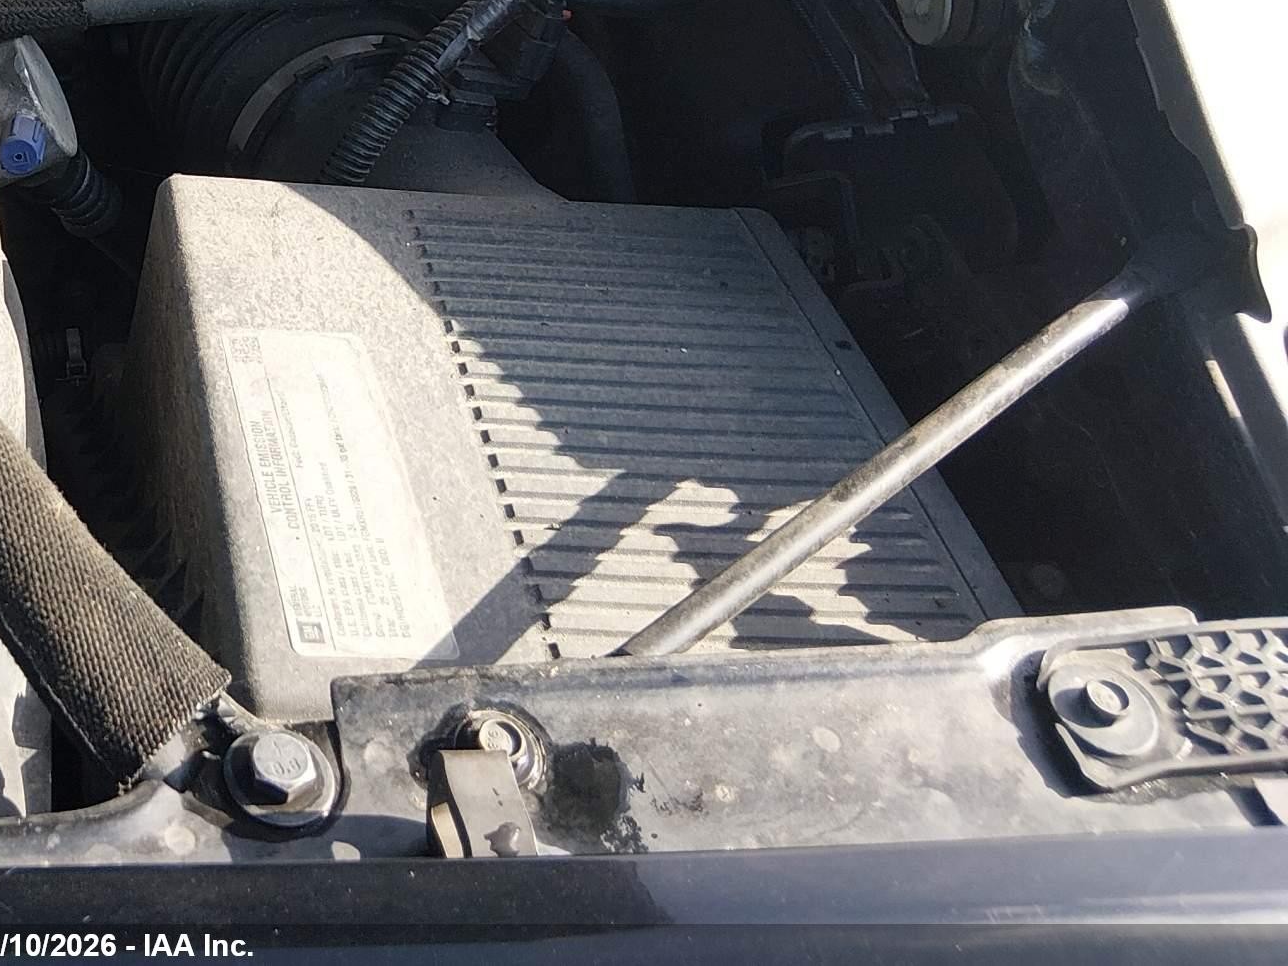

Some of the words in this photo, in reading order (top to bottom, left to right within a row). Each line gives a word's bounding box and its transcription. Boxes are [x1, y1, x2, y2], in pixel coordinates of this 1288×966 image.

[251, 420, 271, 468] EMISSION
[261, 409, 287, 478] INFORMATION
[263, 470, 282, 514] VEHICLE
[278, 479, 300, 529] CONTROL
